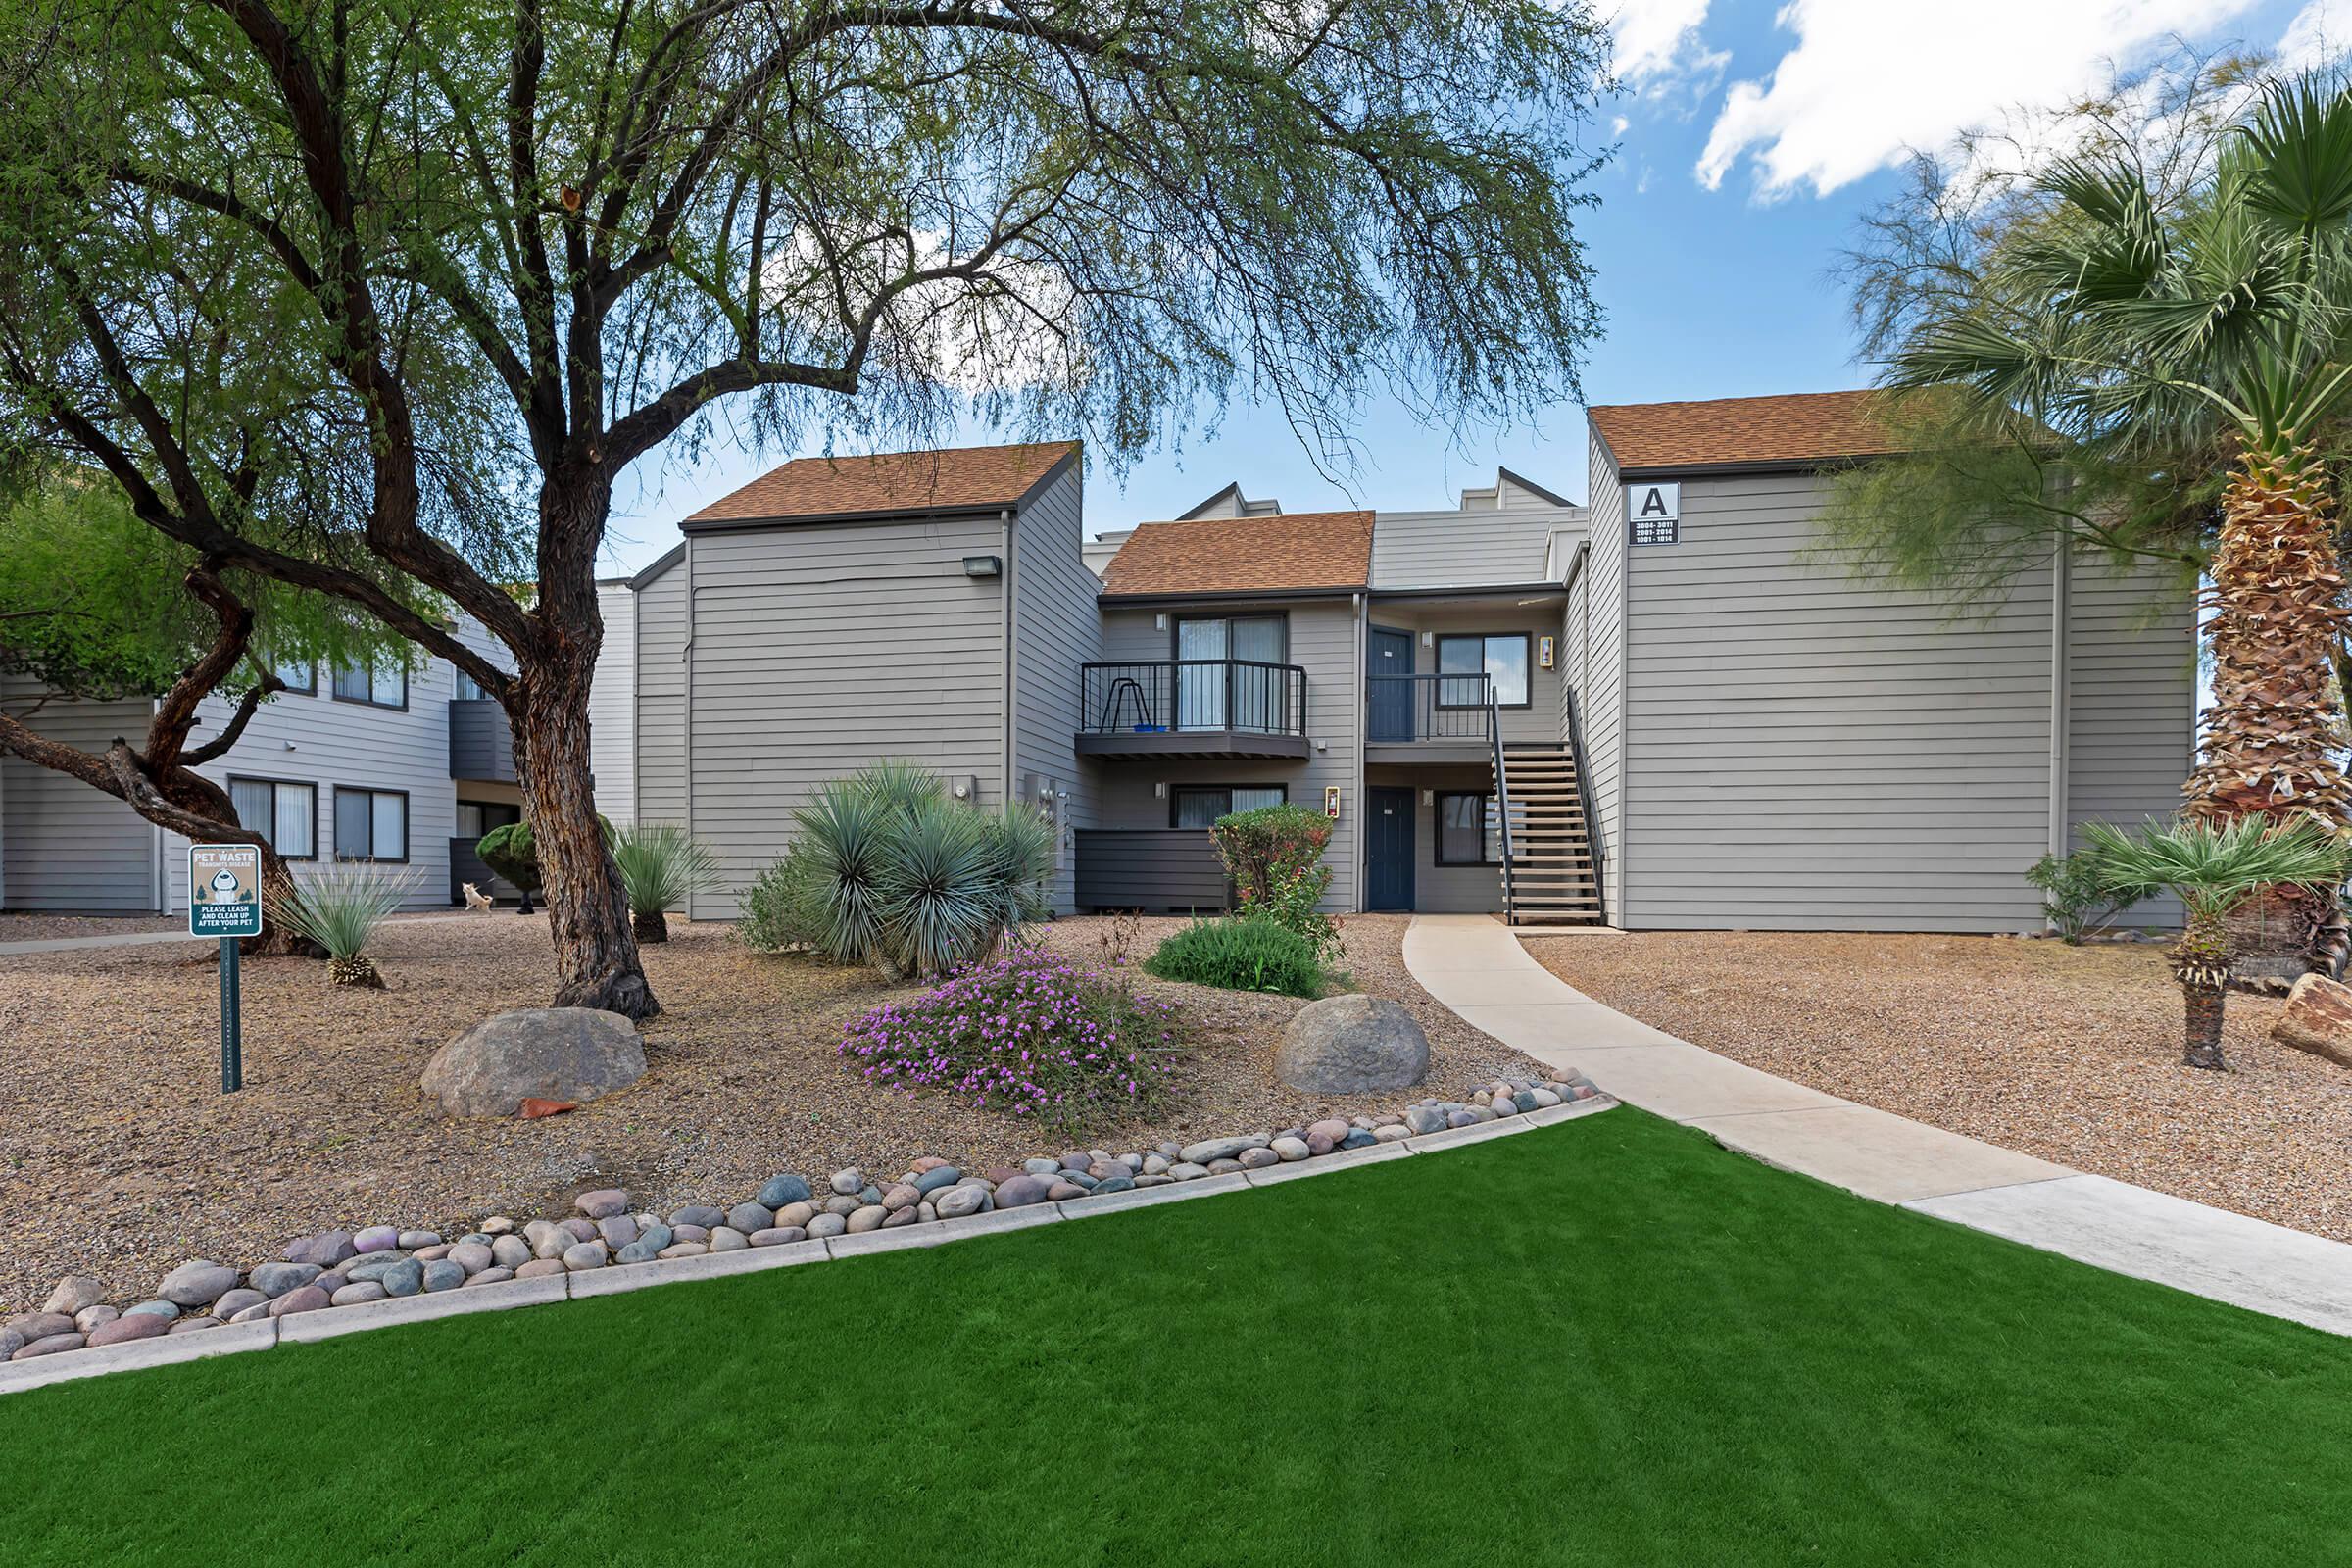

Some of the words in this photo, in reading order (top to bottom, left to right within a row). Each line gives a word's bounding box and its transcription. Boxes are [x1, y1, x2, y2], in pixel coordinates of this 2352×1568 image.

[1641, 488, 1667, 516] A
[195, 853, 216, 862] PET
[219, 853, 255, 862] WASTE
